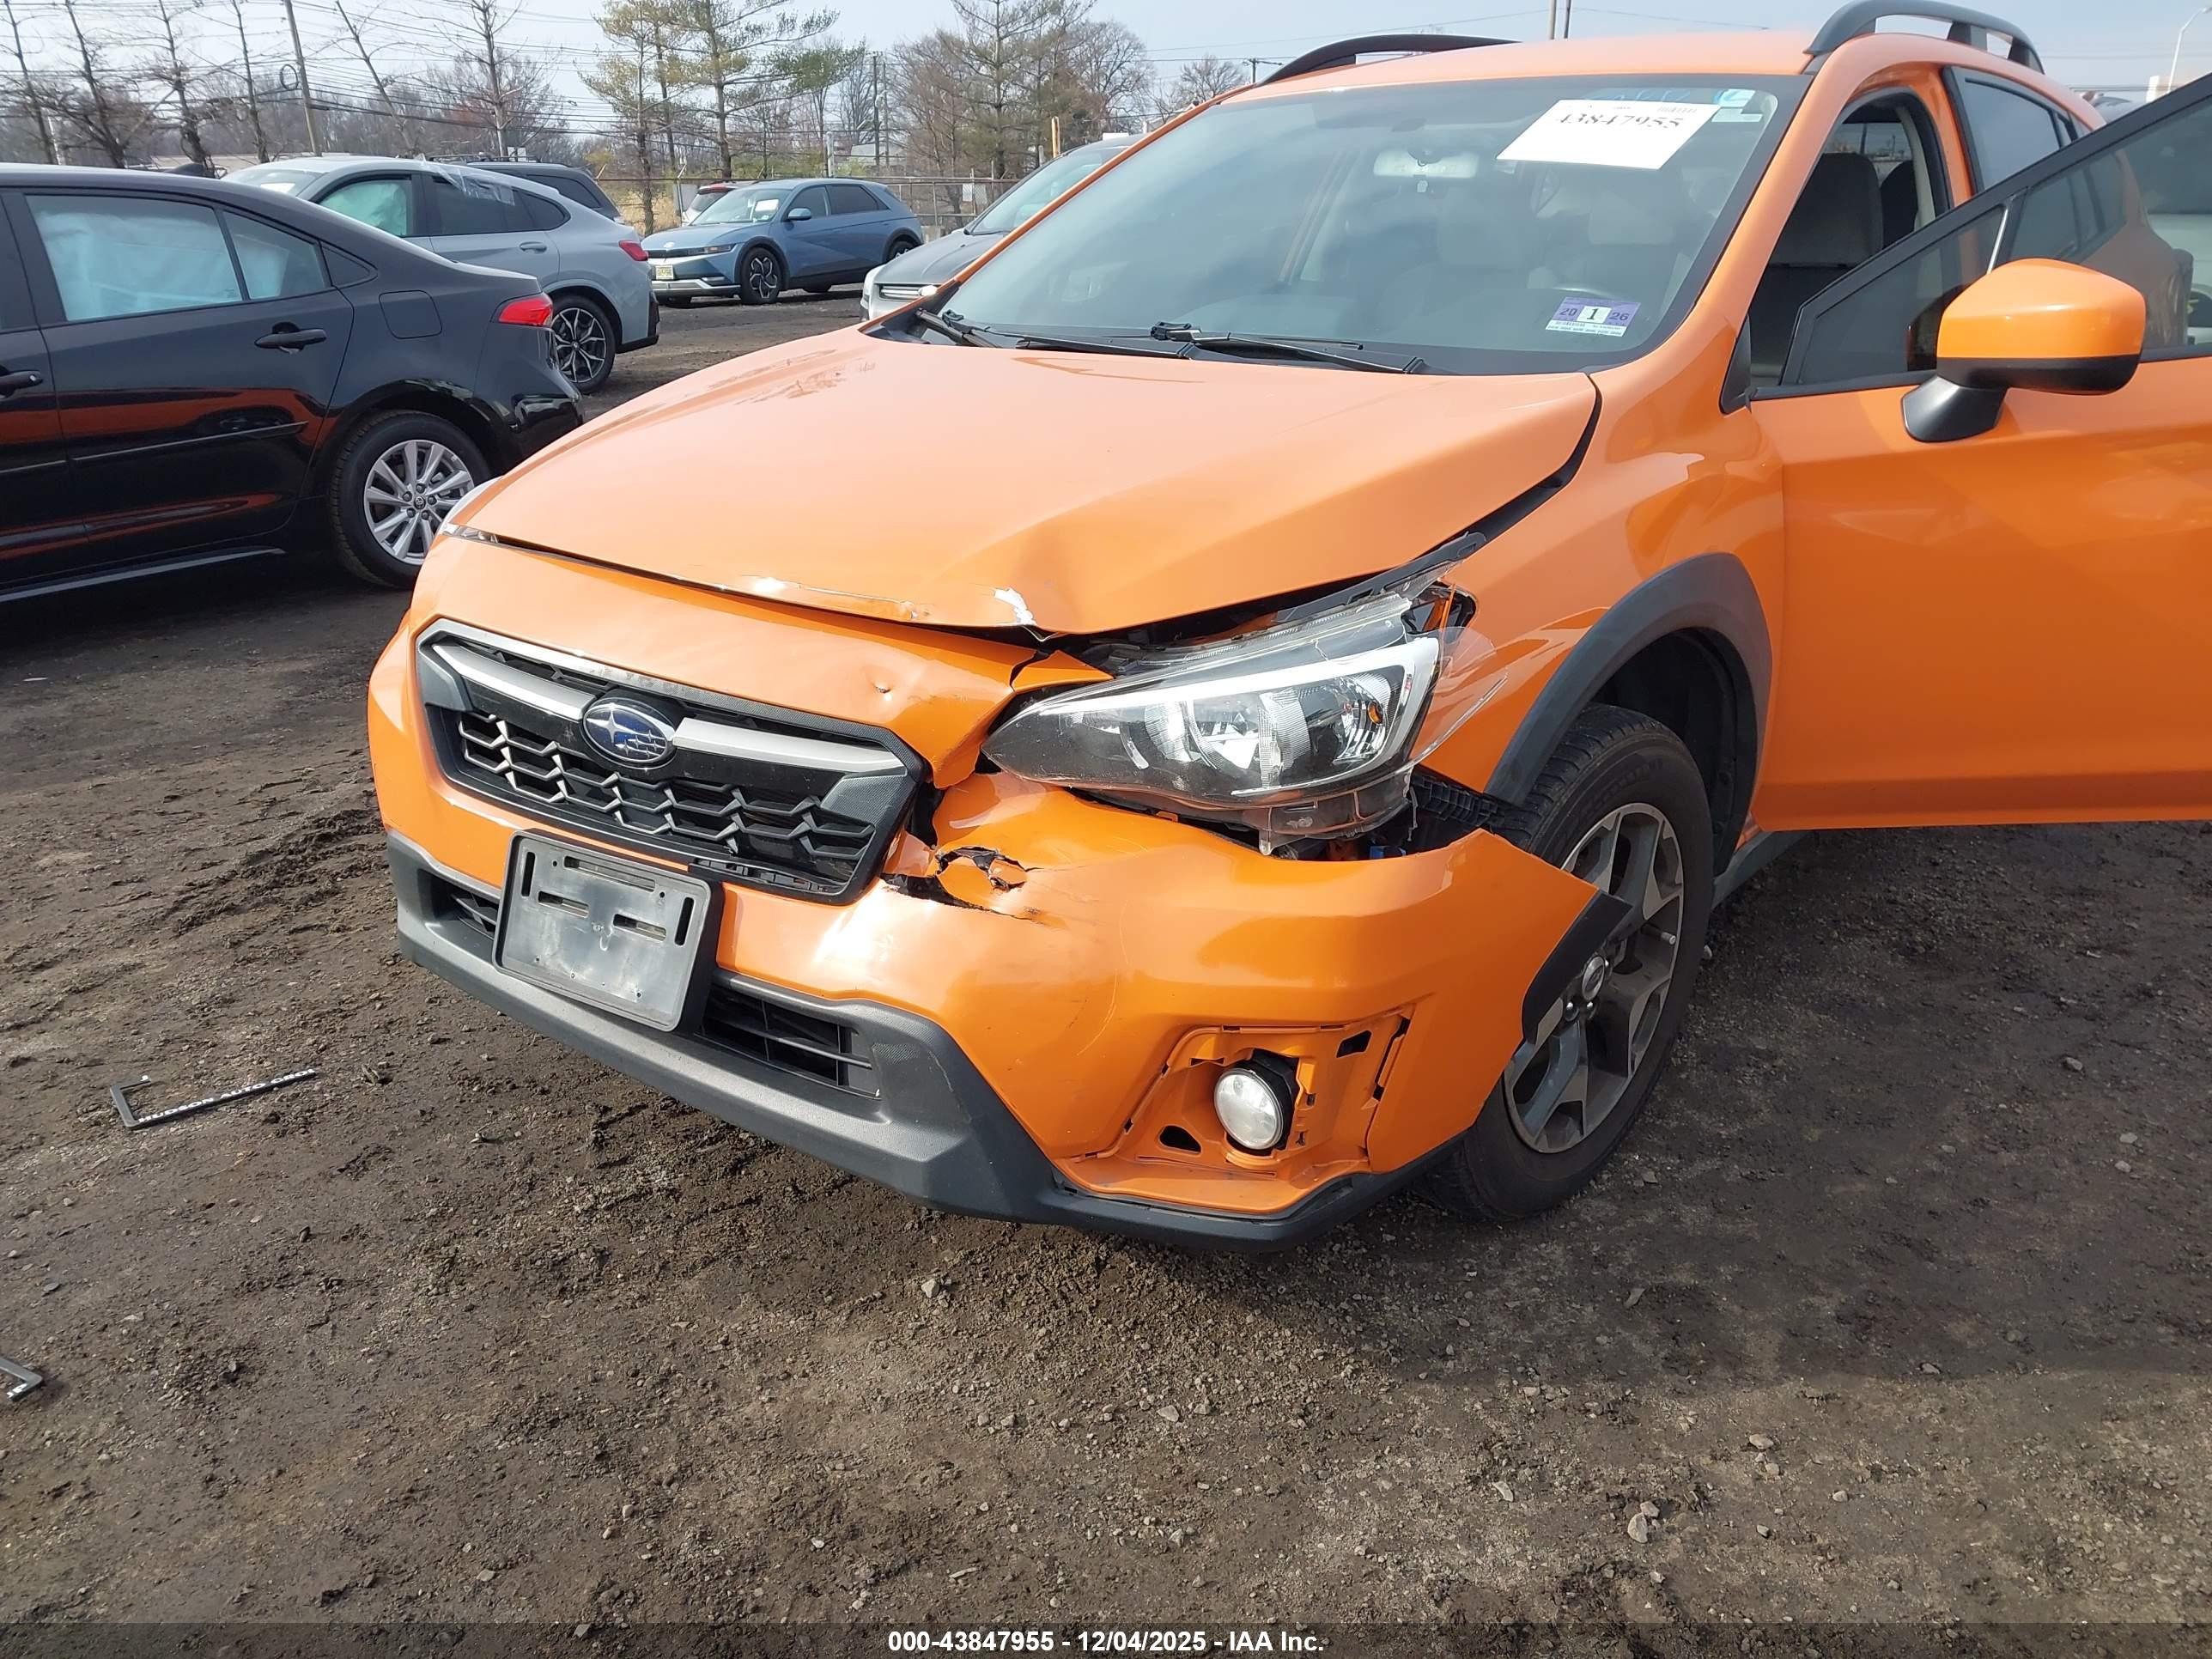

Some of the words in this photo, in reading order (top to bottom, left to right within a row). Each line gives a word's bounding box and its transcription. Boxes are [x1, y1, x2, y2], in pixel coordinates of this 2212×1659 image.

[1555, 112, 1685, 129] 43847955
[1559, 308, 1578, 317] 20
[1586, 307, 1600, 320] 1
[1609, 312, 1630, 321] 26
[137, 1097, 215, 1123] HUDSON
[220, 1082, 266, 1100] AUTO
